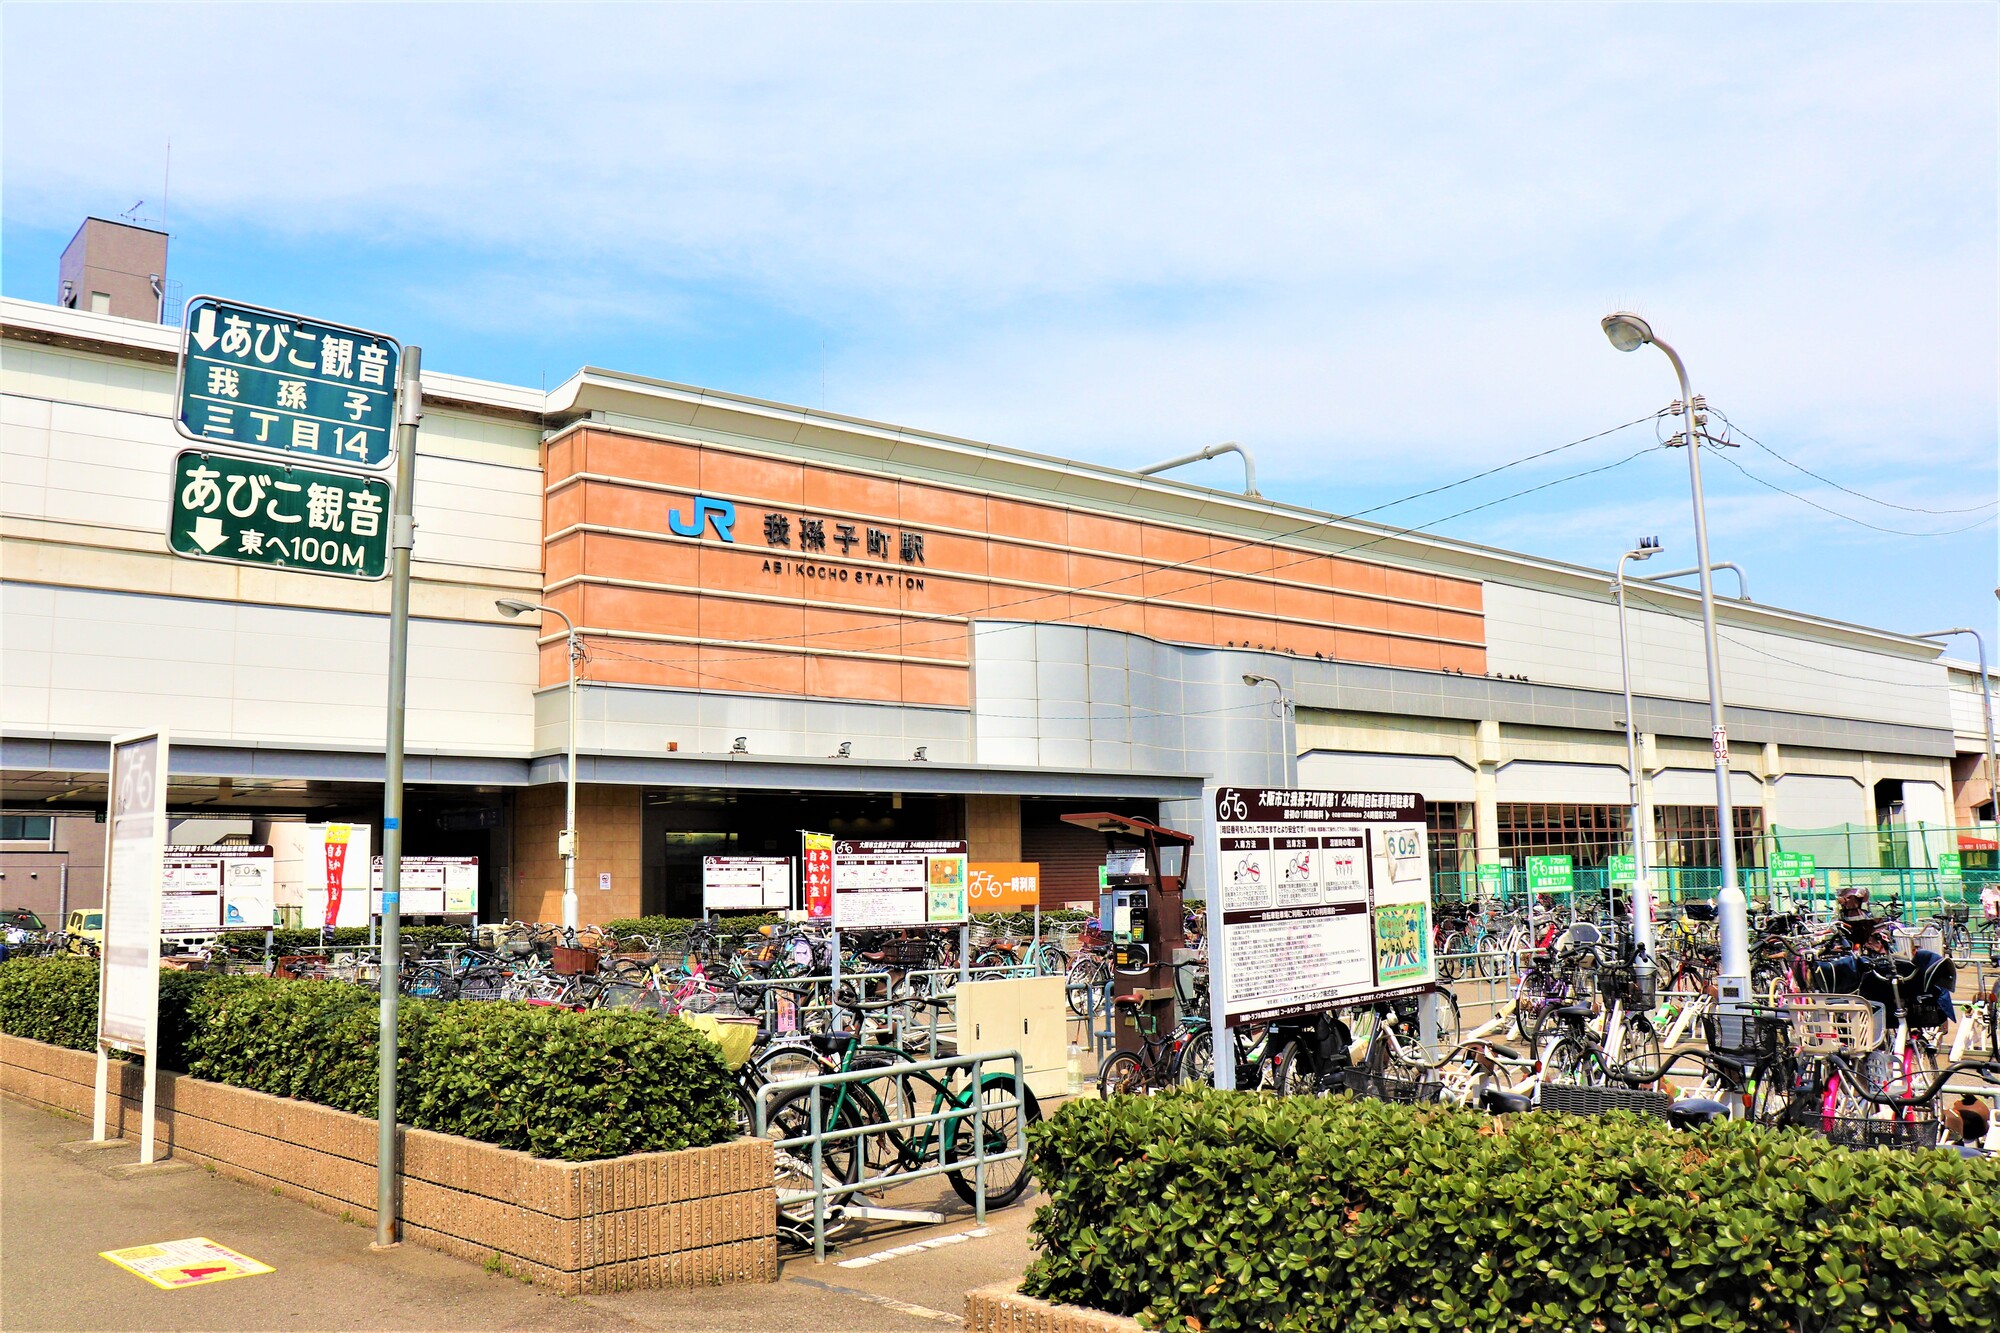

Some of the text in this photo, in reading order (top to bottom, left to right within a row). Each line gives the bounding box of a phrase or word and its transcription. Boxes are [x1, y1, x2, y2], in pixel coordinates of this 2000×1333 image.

[220, 314, 389, 386] あびこ観音
[207, 366, 372, 421] 我孫子
[182, 465, 383, 537] あびこ観音
[669, 496, 735, 543] JR
[238, 529, 365, 569] 東へ100M
[764, 513, 925, 564] 我孫子町駅
[762, 560, 925, 592] ABIKOCHO STATION
[1713, 731, 1726, 740] 77
[1715, 750, 1728, 758] 02
[808, 850, 820, 898] 自転車盗
[1003, 876, 1036, 892] 一時利用
